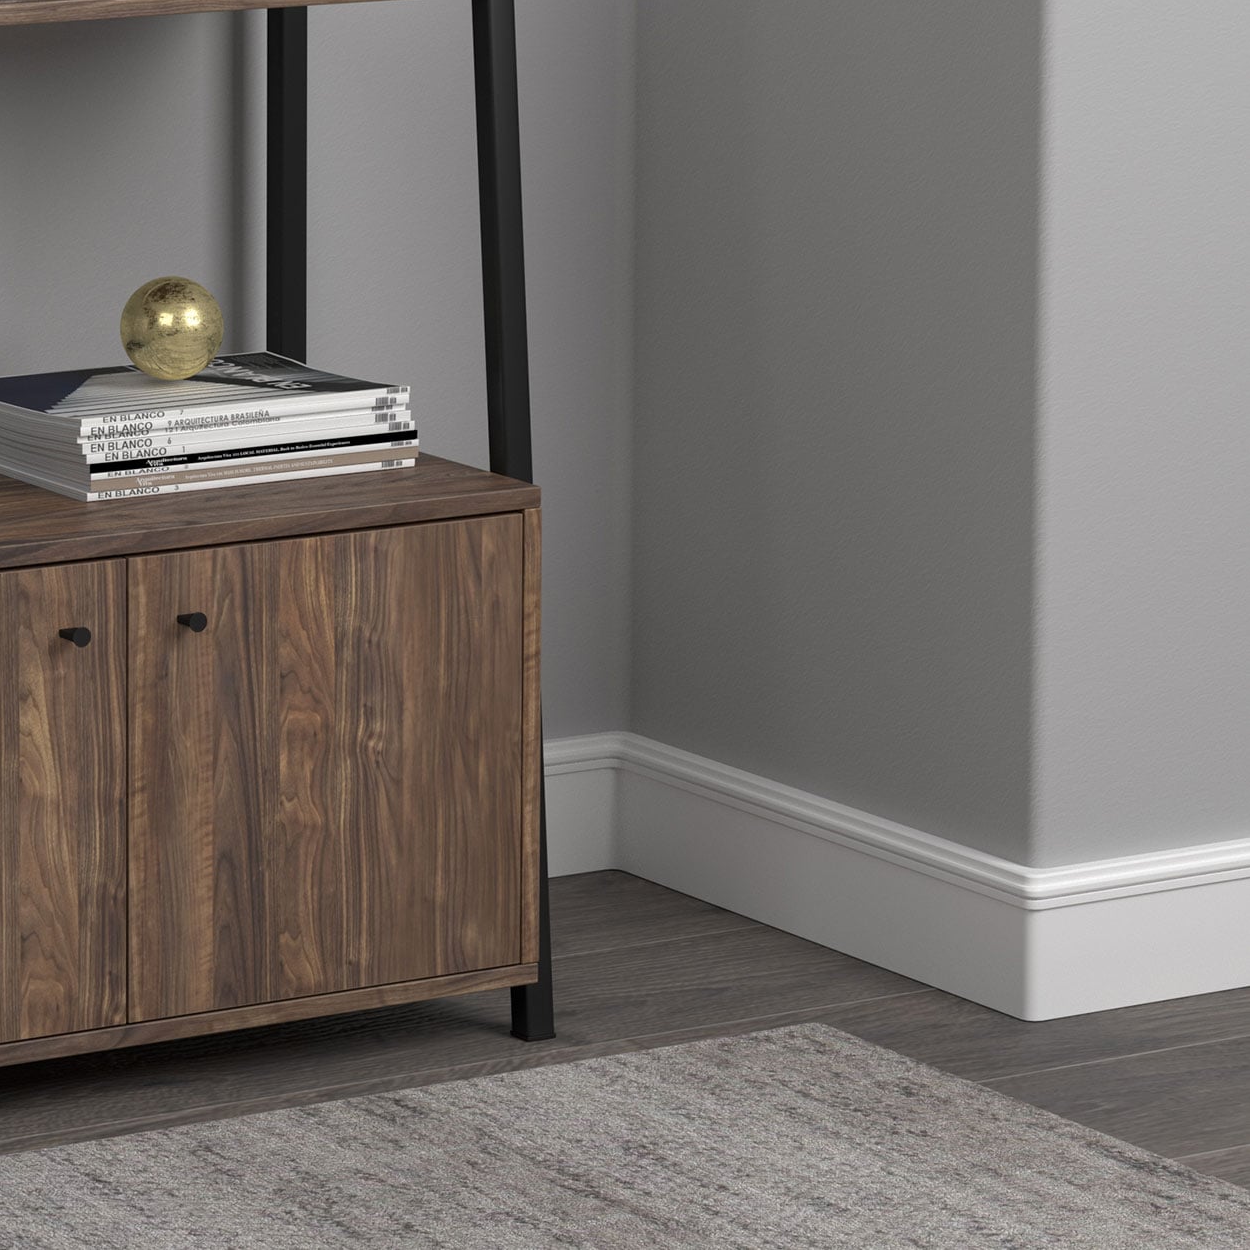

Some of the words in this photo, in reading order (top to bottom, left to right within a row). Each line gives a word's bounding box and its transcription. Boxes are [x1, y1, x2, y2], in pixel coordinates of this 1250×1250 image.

[90, 425, 105, 436] EN
[108, 421, 153, 435] BLANCO
[174, 414, 228, 426] ARQUITECTURA
[230, 409, 270, 420] BRASILEÑA
[103, 415, 117, 424] EN
[120, 411, 165, 422] BLANCO
[87, 433, 101, 441] EN
[104, 429, 150, 440] BLANCO
[90, 443, 105, 453] EN
[108, 438, 153, 451] BLANCO
[167, 437, 172, 445] 6
[104, 452, 119, 462] EN
[122, 447, 167, 460] BLANCO
[125, 466, 170, 476] BLANCO
[98, 491, 112, 499] EN
[115, 486, 160, 497] BLANCO
